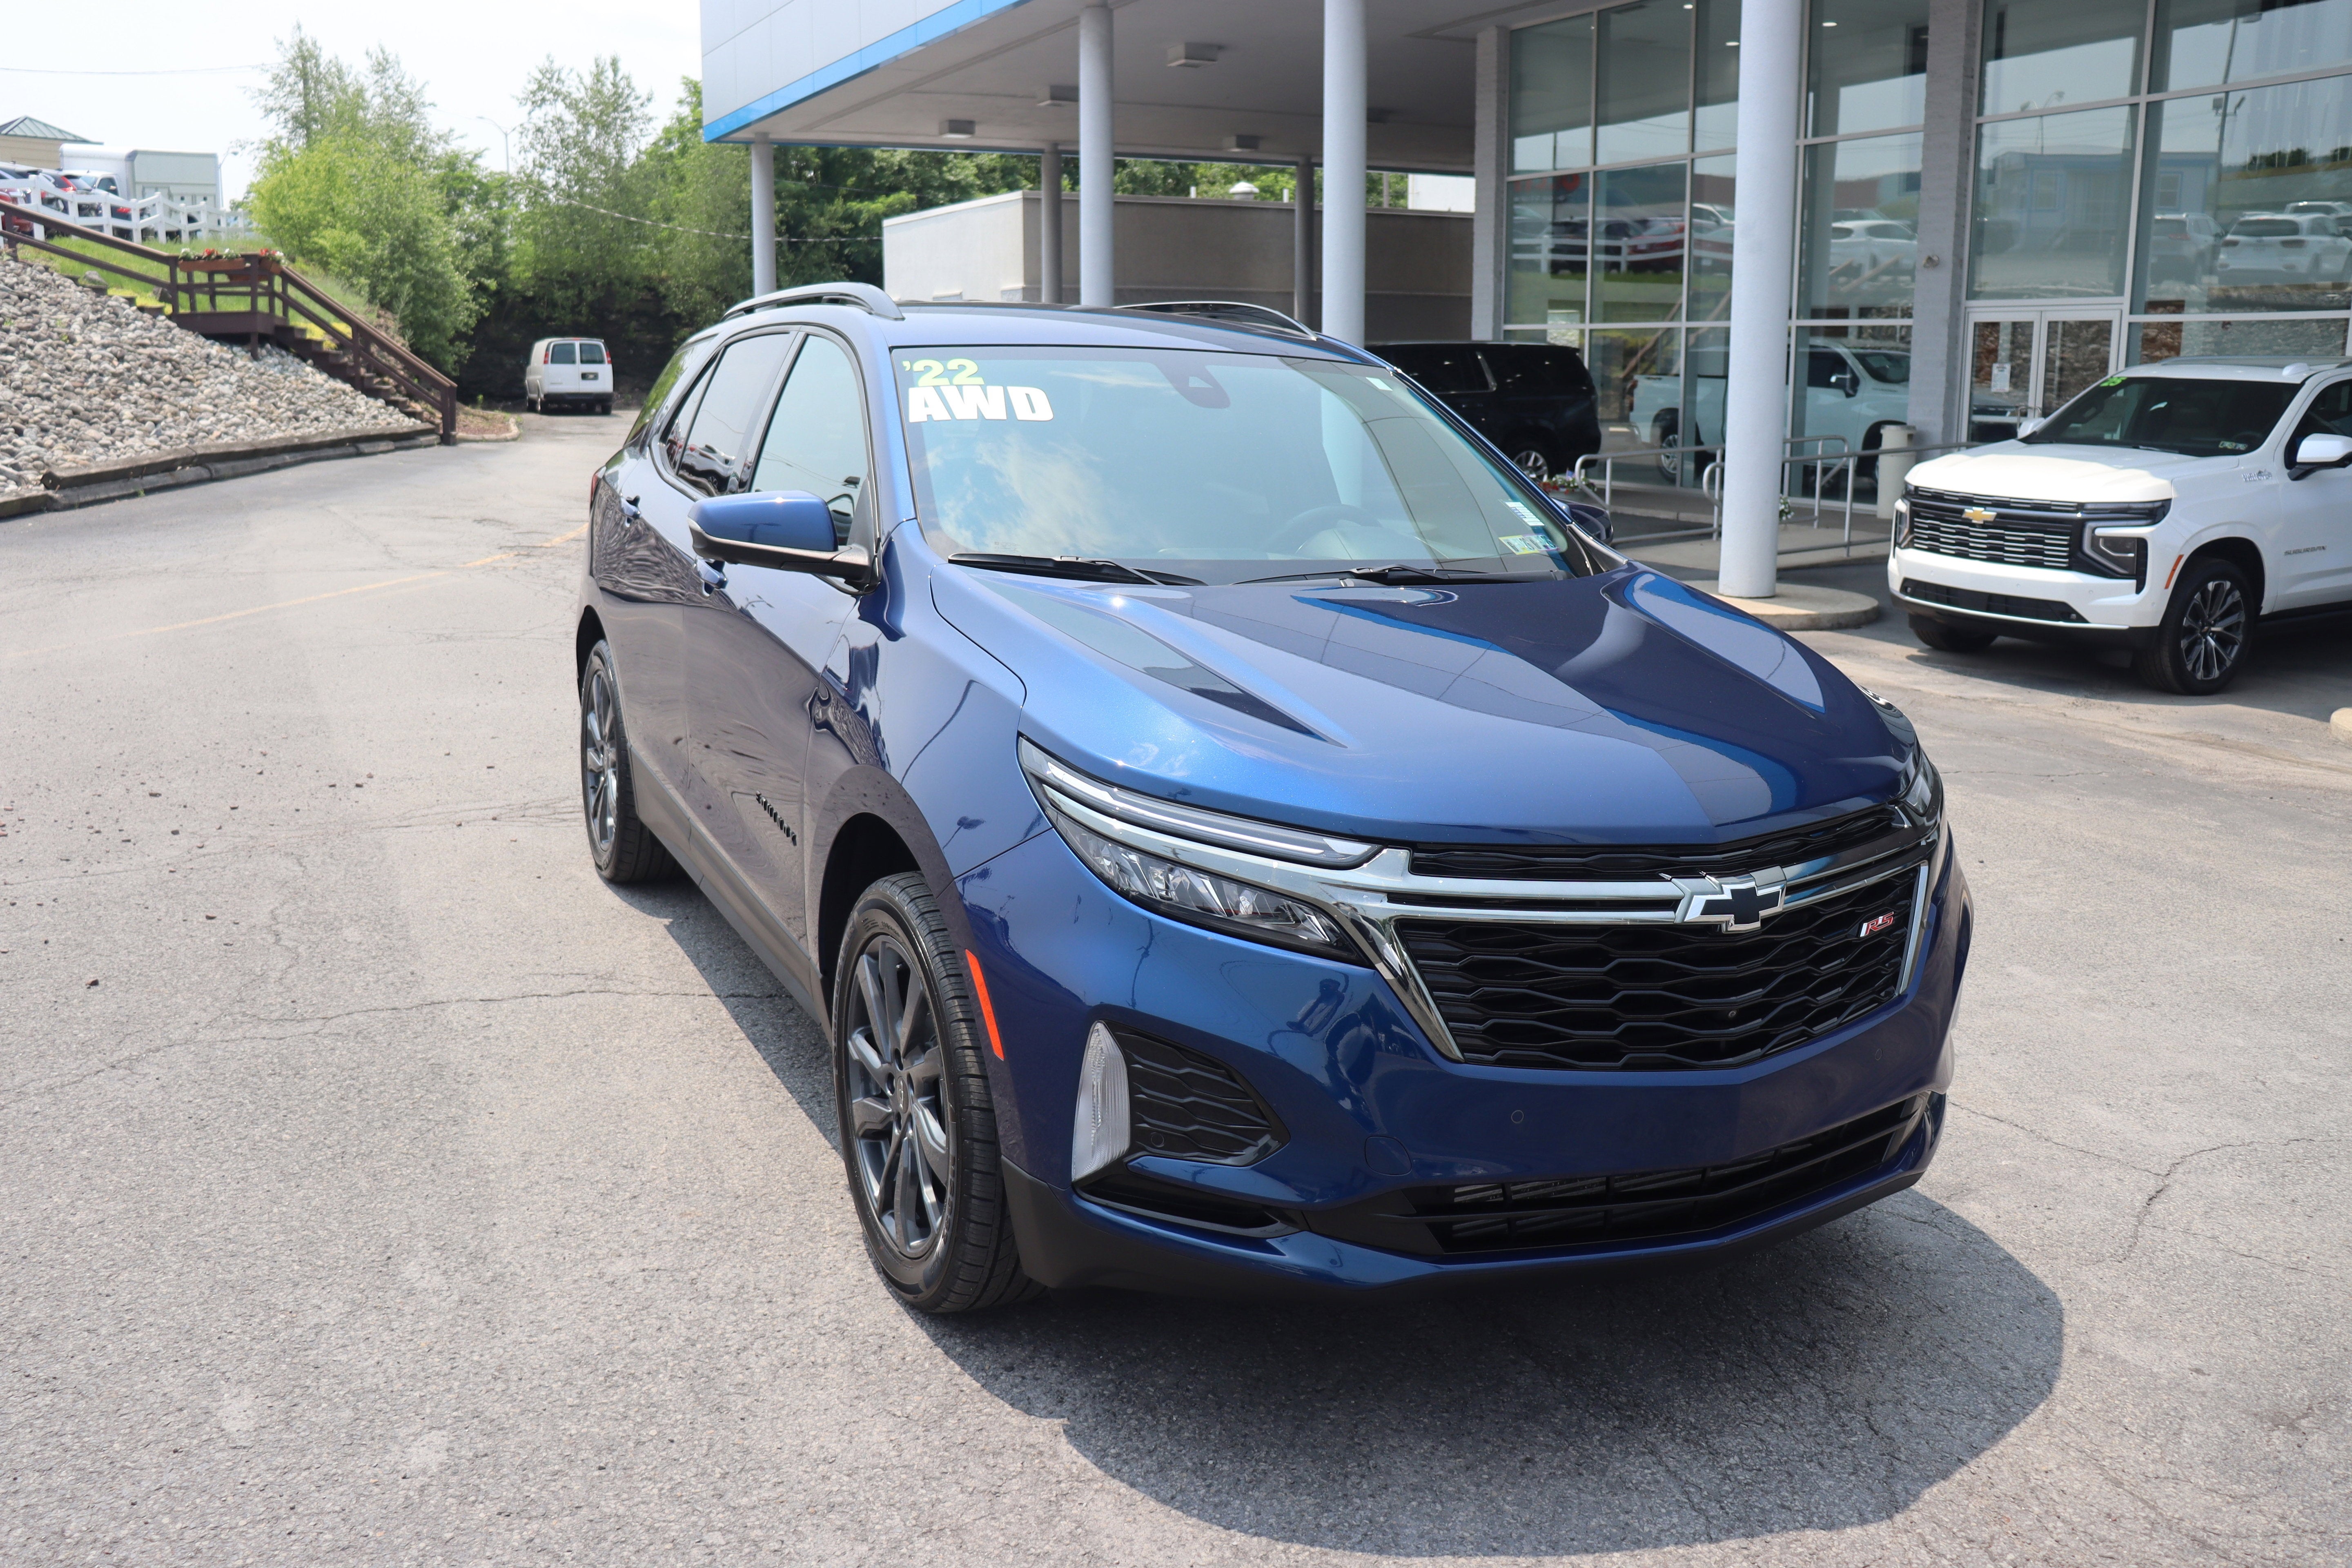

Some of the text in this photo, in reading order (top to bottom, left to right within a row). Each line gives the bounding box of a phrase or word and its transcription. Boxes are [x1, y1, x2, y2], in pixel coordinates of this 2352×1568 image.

[902, 358, 985, 387] '22
[908, 385, 1054, 423] AWD
[1859, 911, 1895, 938] RS
